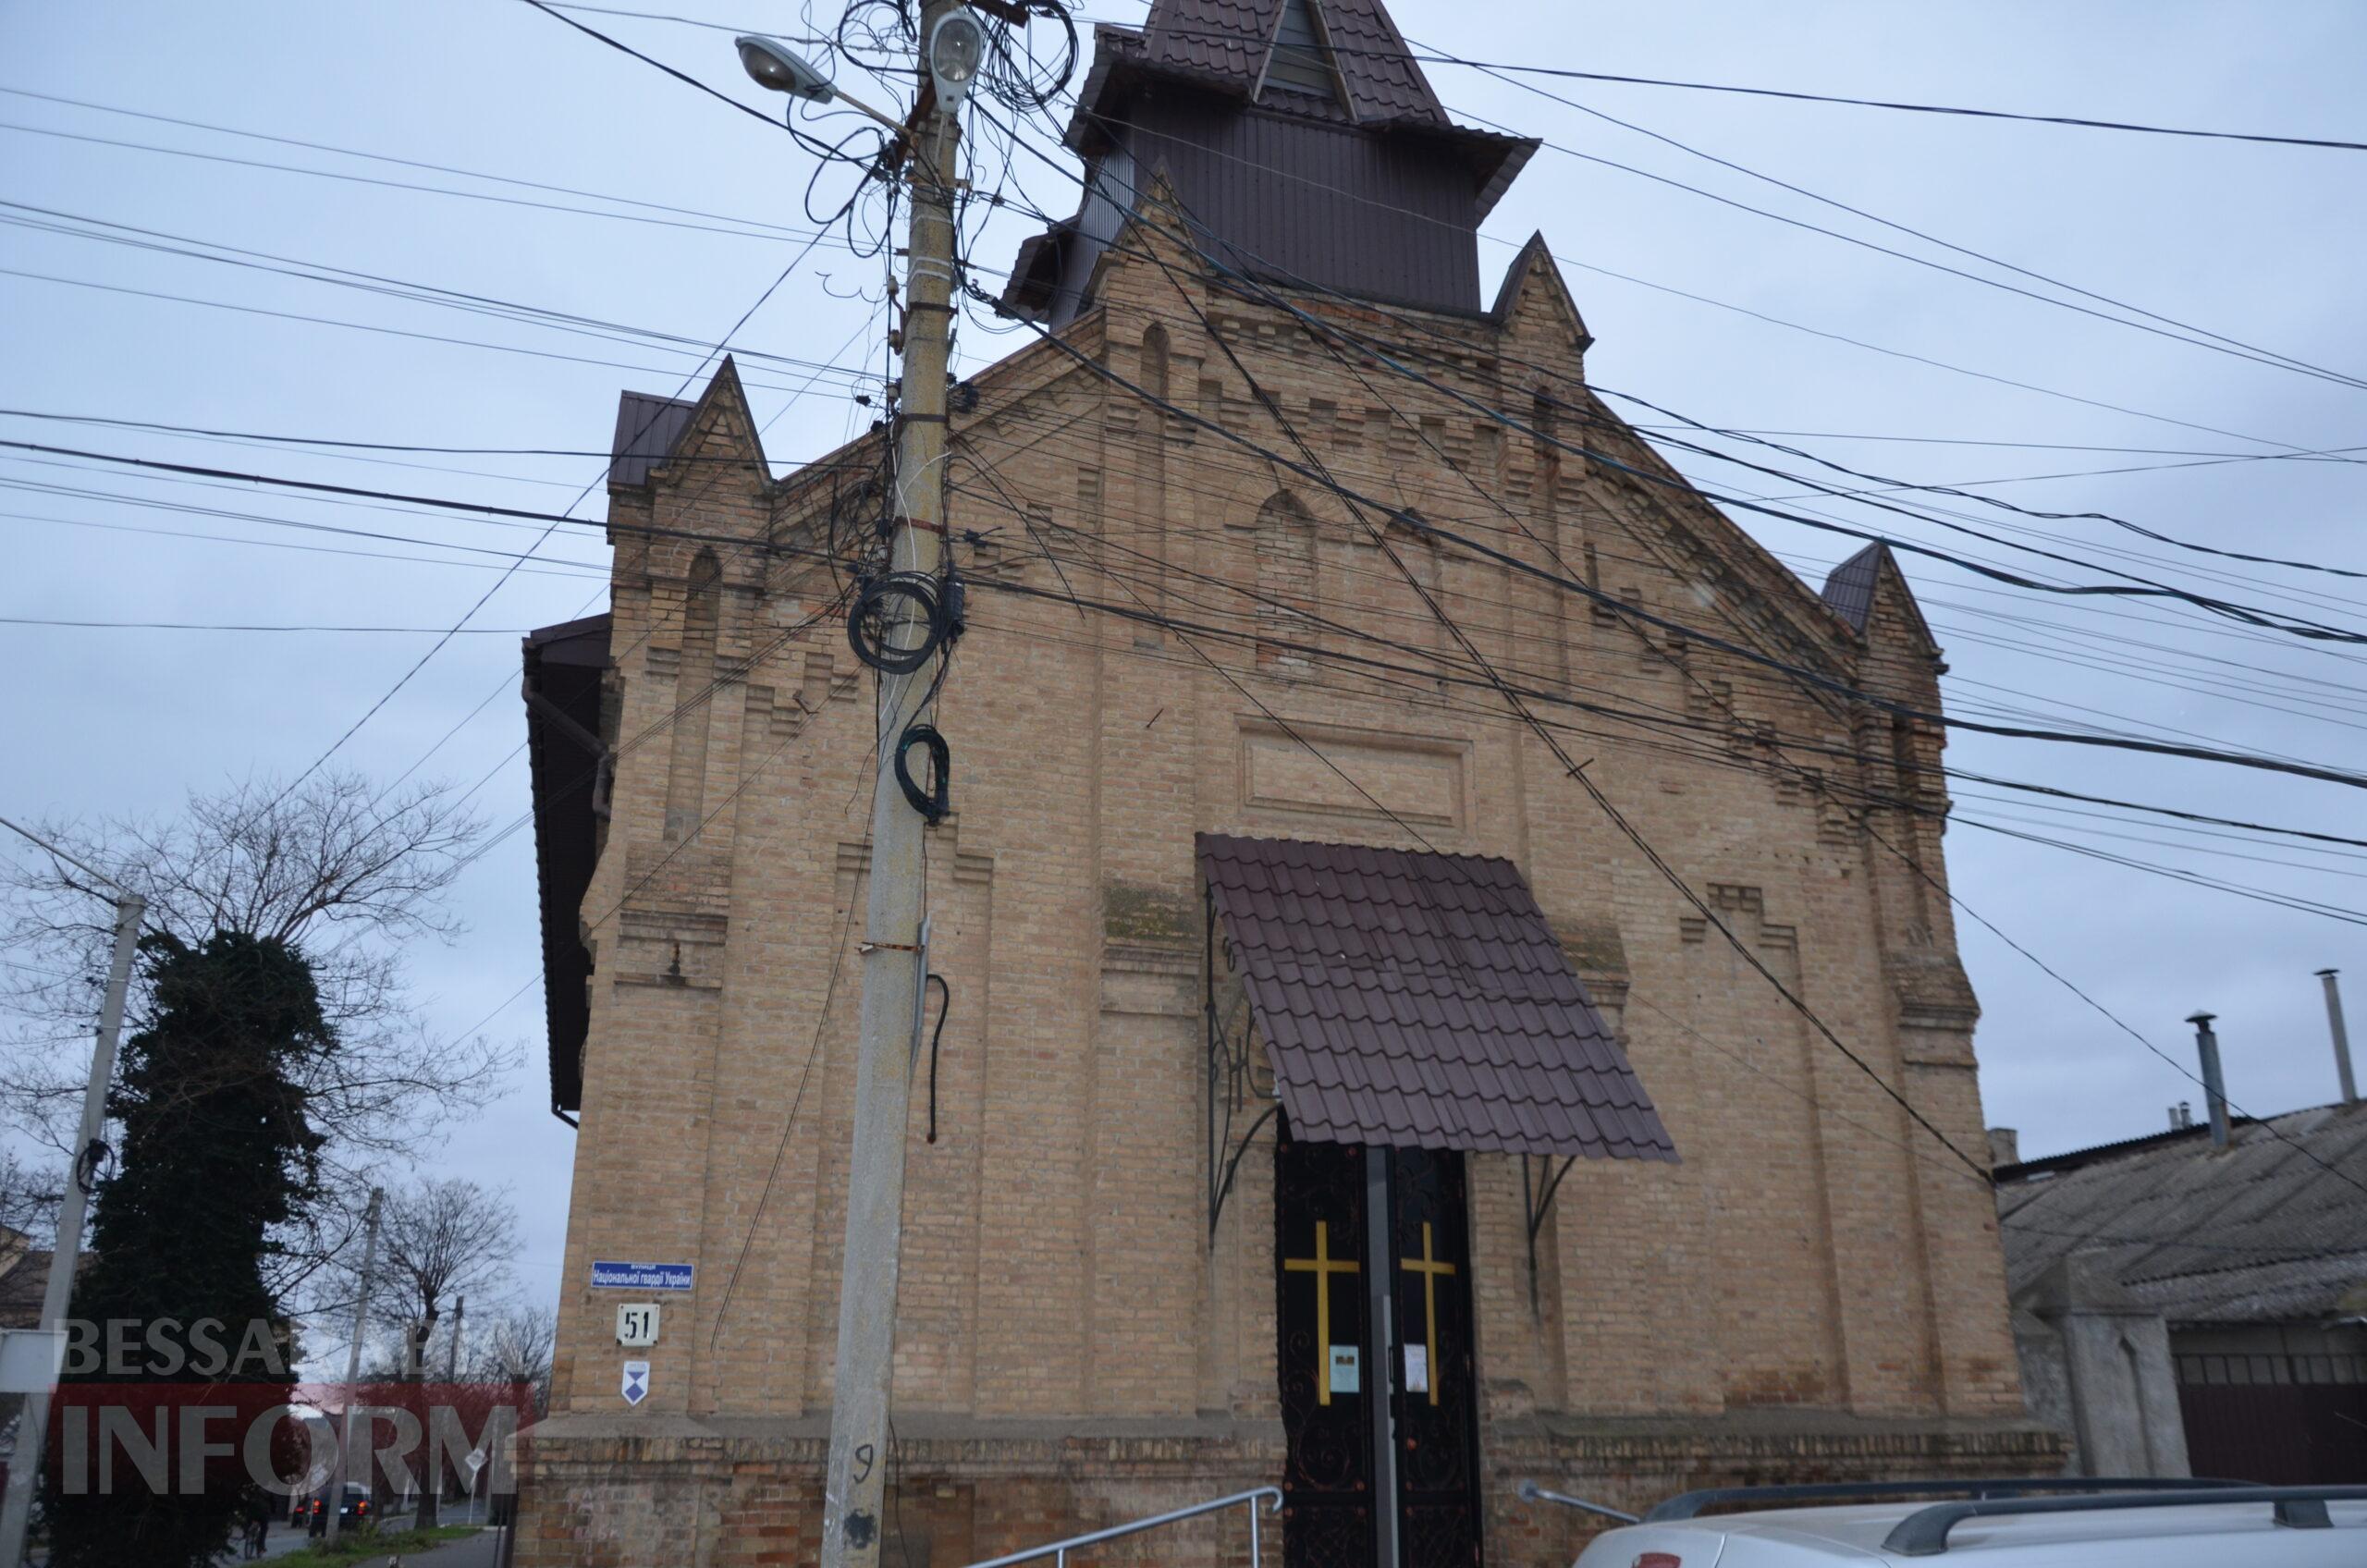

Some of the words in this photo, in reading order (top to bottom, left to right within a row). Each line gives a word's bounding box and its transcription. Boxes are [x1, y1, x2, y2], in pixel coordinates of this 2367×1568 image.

[594, 1269, 640, 1285] Національної
[665, 1271, 691, 1288] України
[624, 1311, 649, 1340] 51
[852, 1443, 874, 1485] 9
